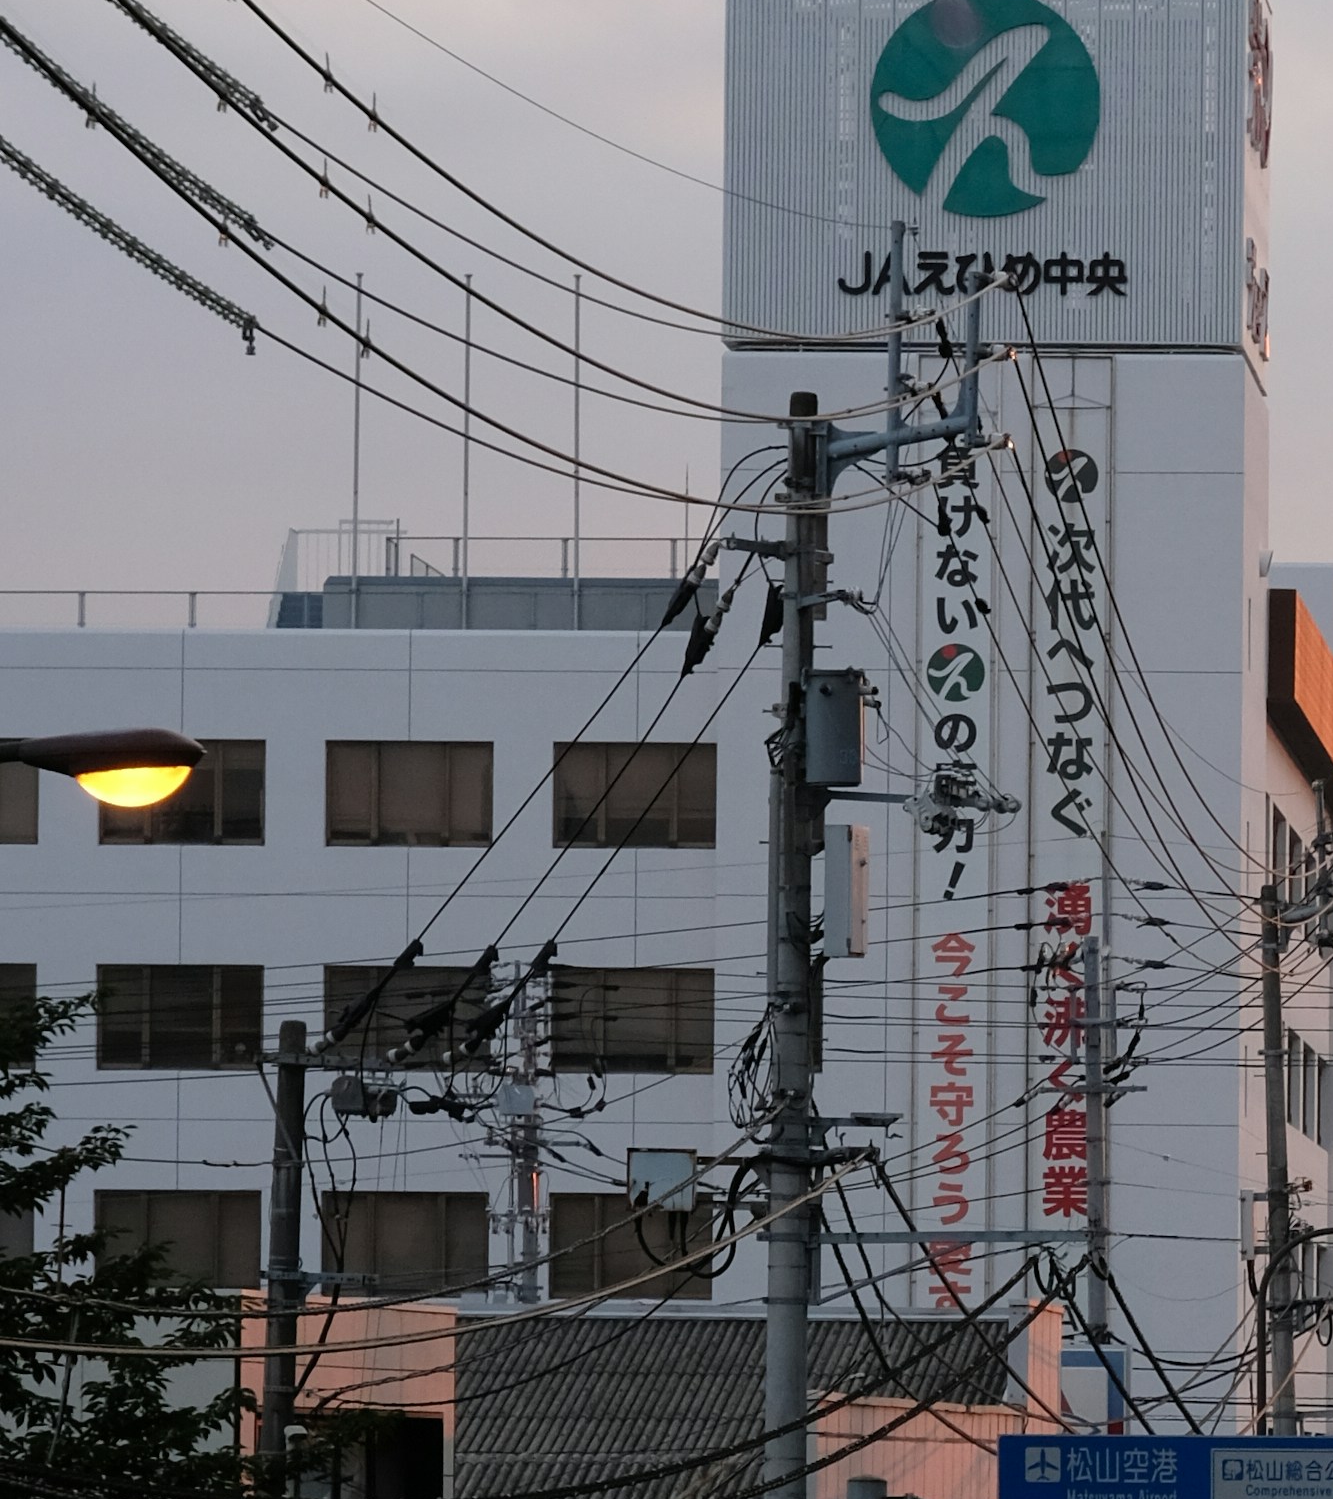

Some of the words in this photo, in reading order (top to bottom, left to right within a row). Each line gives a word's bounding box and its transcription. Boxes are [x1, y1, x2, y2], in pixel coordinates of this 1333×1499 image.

[1046, 521, 1096, 837] 次代へつなぐ
[1066, 1447, 1178, 1484] 松山空港
[1246, 1484, 1331, 1498] Comprehensive
